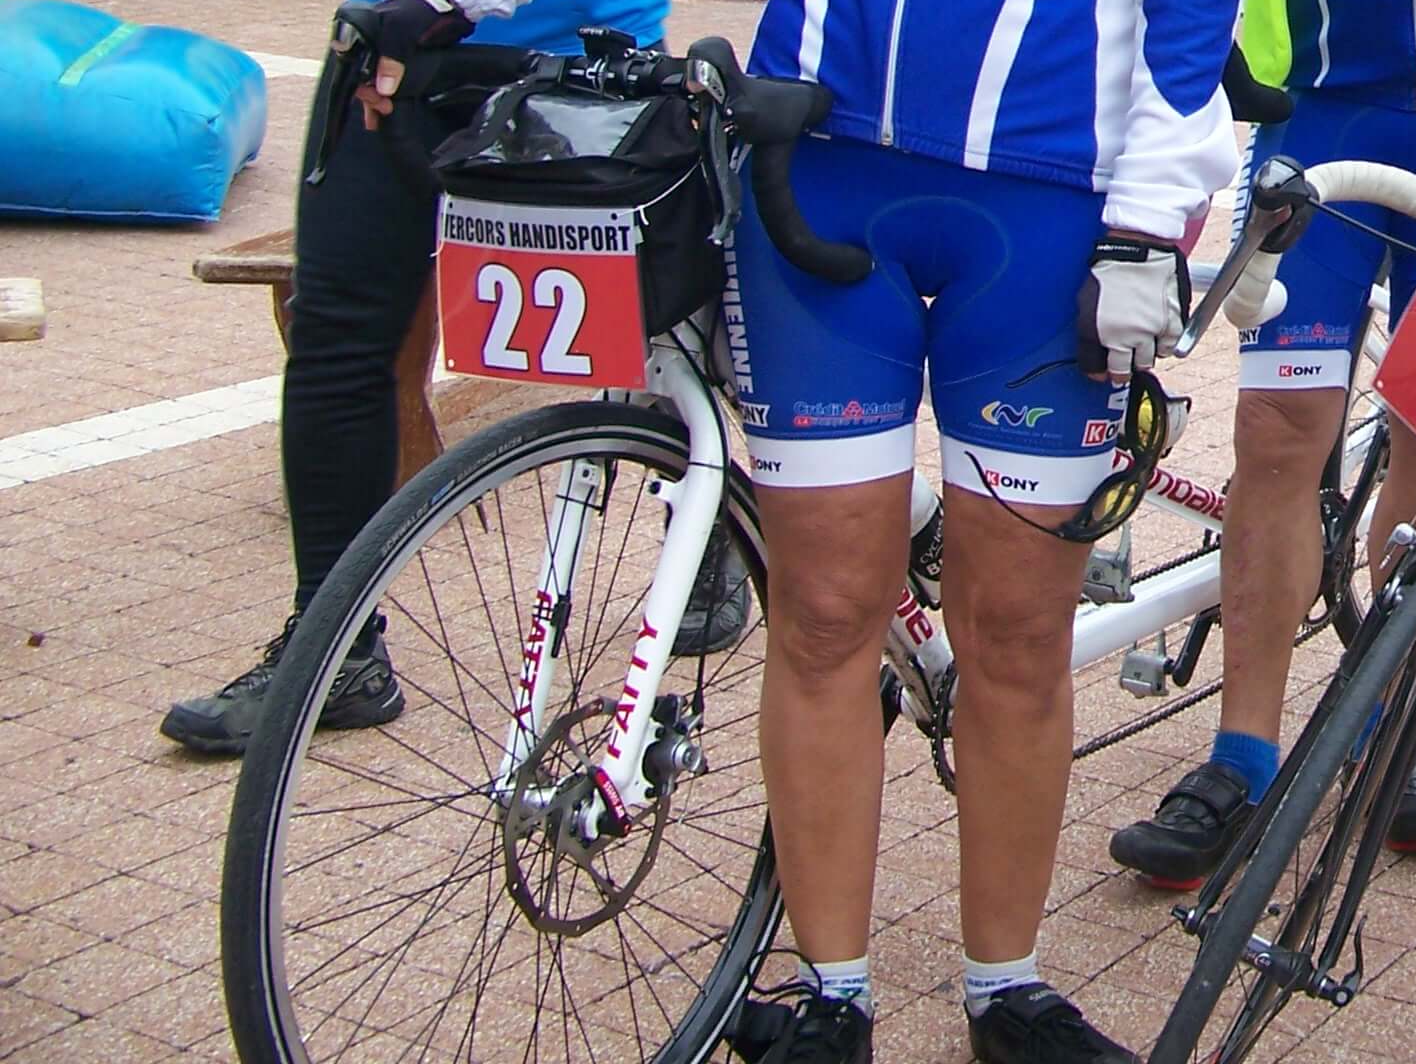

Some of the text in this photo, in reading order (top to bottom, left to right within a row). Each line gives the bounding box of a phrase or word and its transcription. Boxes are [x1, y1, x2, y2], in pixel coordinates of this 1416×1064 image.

[509, 222, 631, 252] HANDISPORT
[476, 262, 592, 376] 22
[1279, 365, 1322, 377] KONY
[984, 469, 1039, 492] KONY
